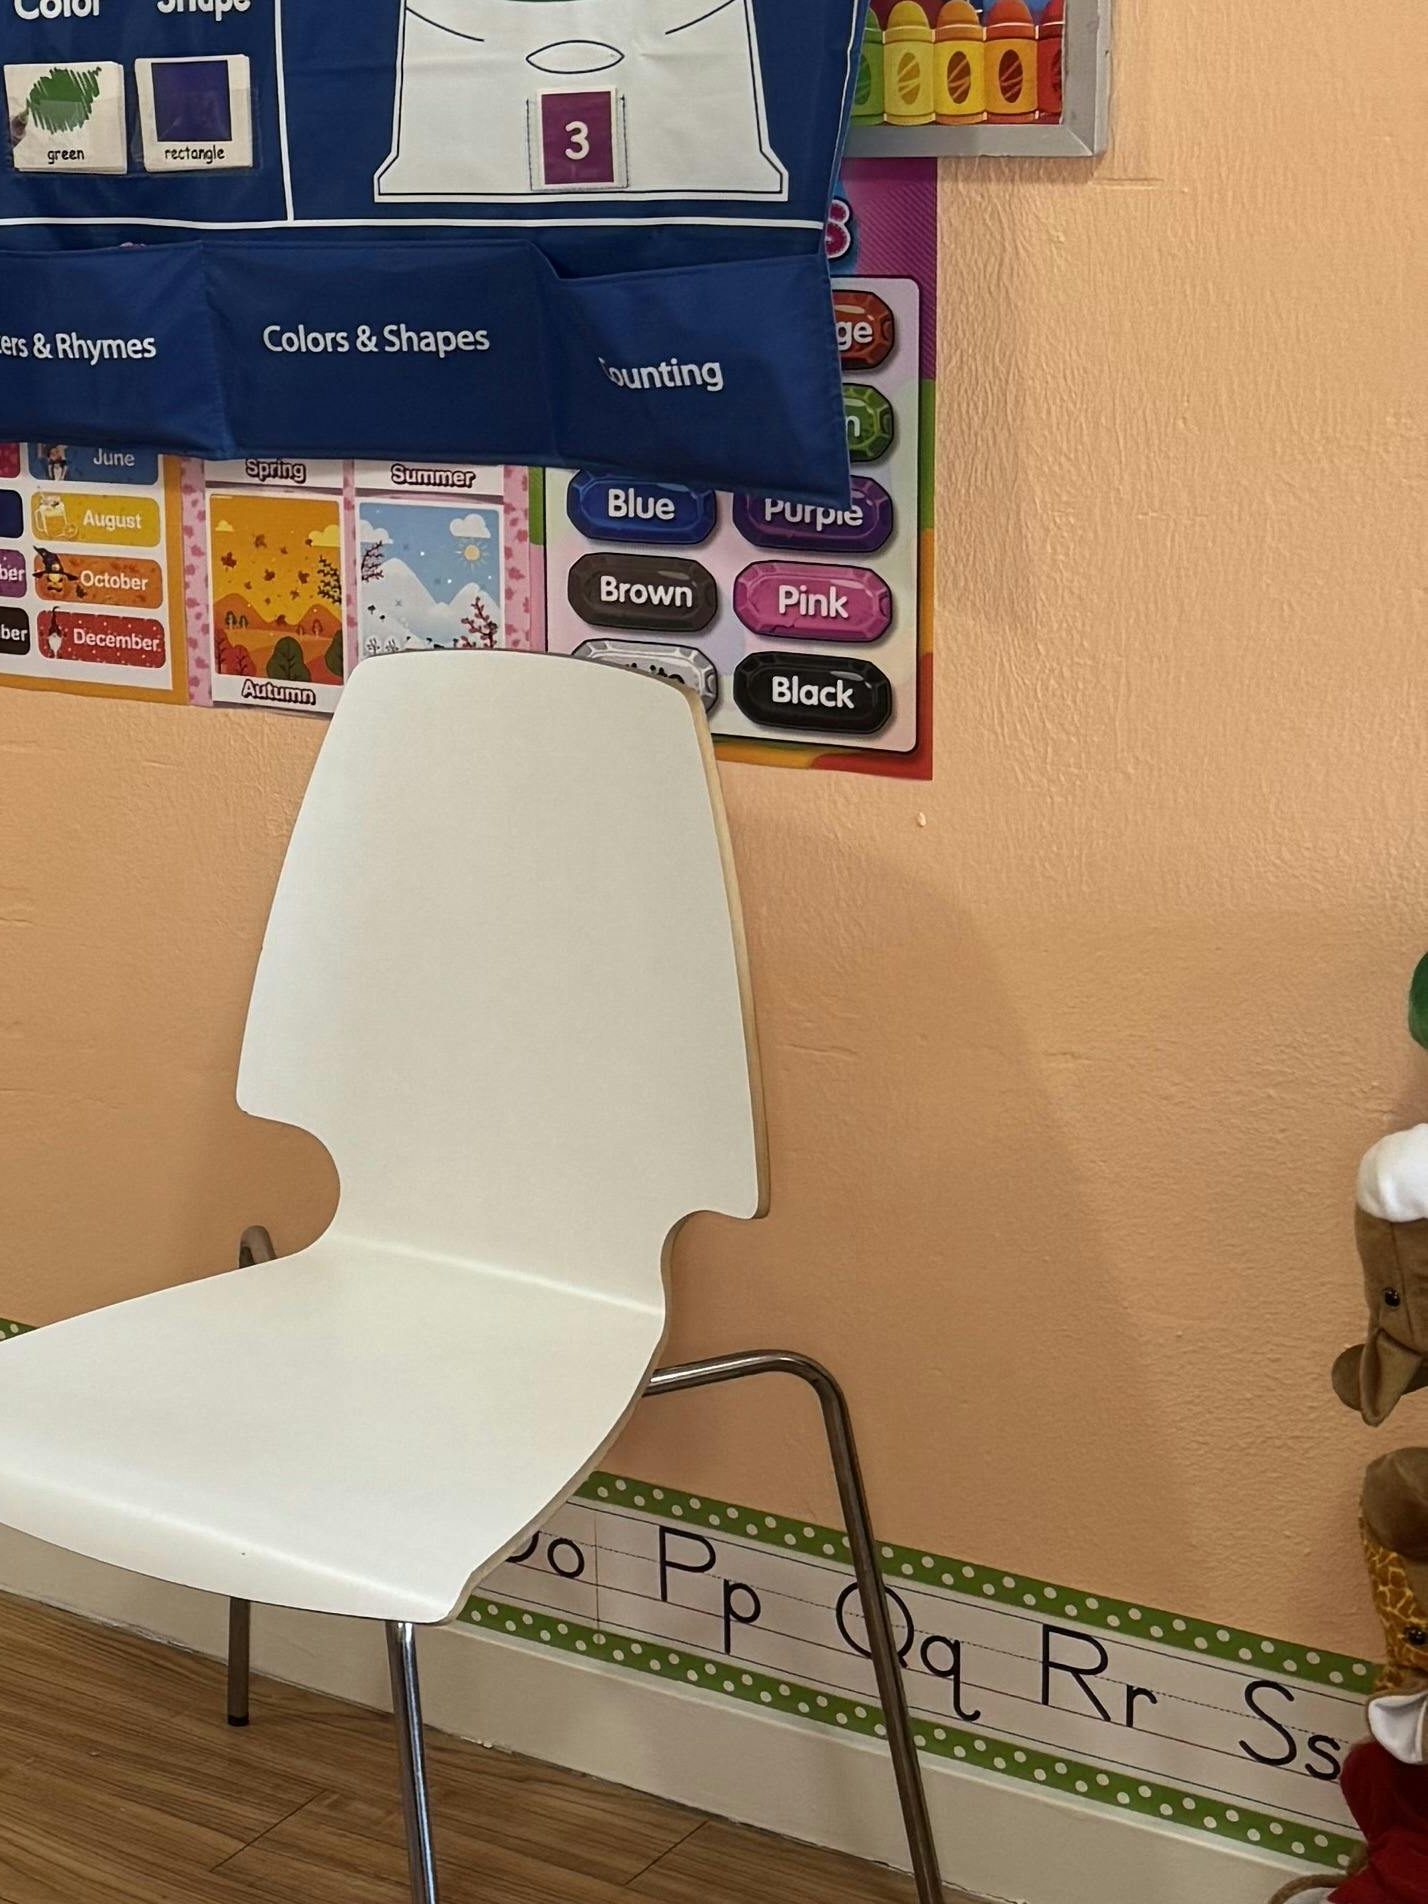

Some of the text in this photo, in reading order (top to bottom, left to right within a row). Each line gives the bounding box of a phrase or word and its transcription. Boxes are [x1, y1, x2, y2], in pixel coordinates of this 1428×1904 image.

[565, 120, 590, 160] 3
[46, 146, 85, 165] green
[163, 143, 225, 163] rectangle
[33, 332, 53, 359] &
[55, 332, 157, 366] Rhymes
[263, 323, 490, 358] Colors & Shapes
[93, 448, 134, 467] June
[246, 459, 306, 483] Spring
[390, 465, 476, 487] Summer
[607, 489, 675, 522] Blue
[82, 510, 142, 531] August
[80, 570, 149, 591] October
[600, 576, 693, 607] Brown
[778, 587, 849, 618] Pink
[73, 628, 160, 651] December
[242, 680, 316, 704] Autumn
[771, 677, 854, 709] Black
[658, 1525, 763, 1654] Pp
[834, 1579, 982, 1723] Qq
[1042, 1624, 1157, 1728] Rr
[1240, 1680, 1343, 1782] Ss
